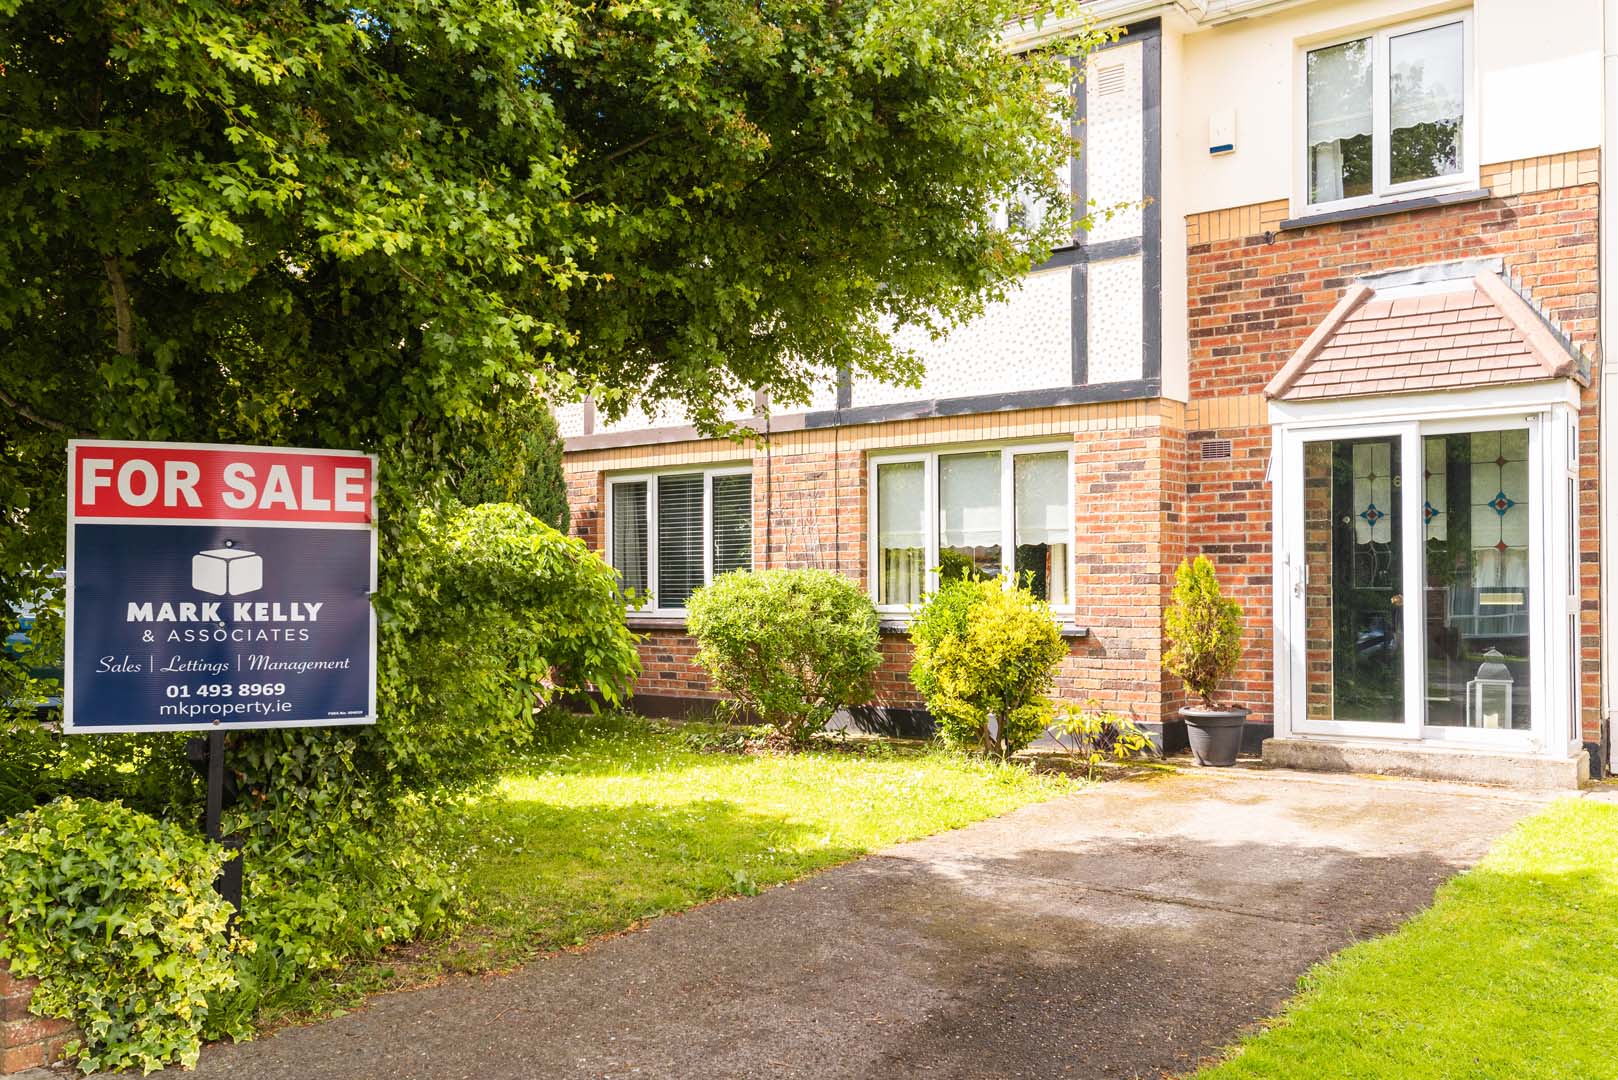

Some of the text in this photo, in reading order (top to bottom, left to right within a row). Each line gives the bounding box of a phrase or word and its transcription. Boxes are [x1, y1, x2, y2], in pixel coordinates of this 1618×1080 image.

[82, 458, 366, 512] FOR SALE
[126, 602, 324, 622] MARK KELLY
[142, 629, 309, 642] & ASSOCIATES
[96, 654, 351, 675] Sales Lettings Management
[166, 683, 286, 698] 01 493 8969
[160, 700, 293, 717] mkproperty.ie
